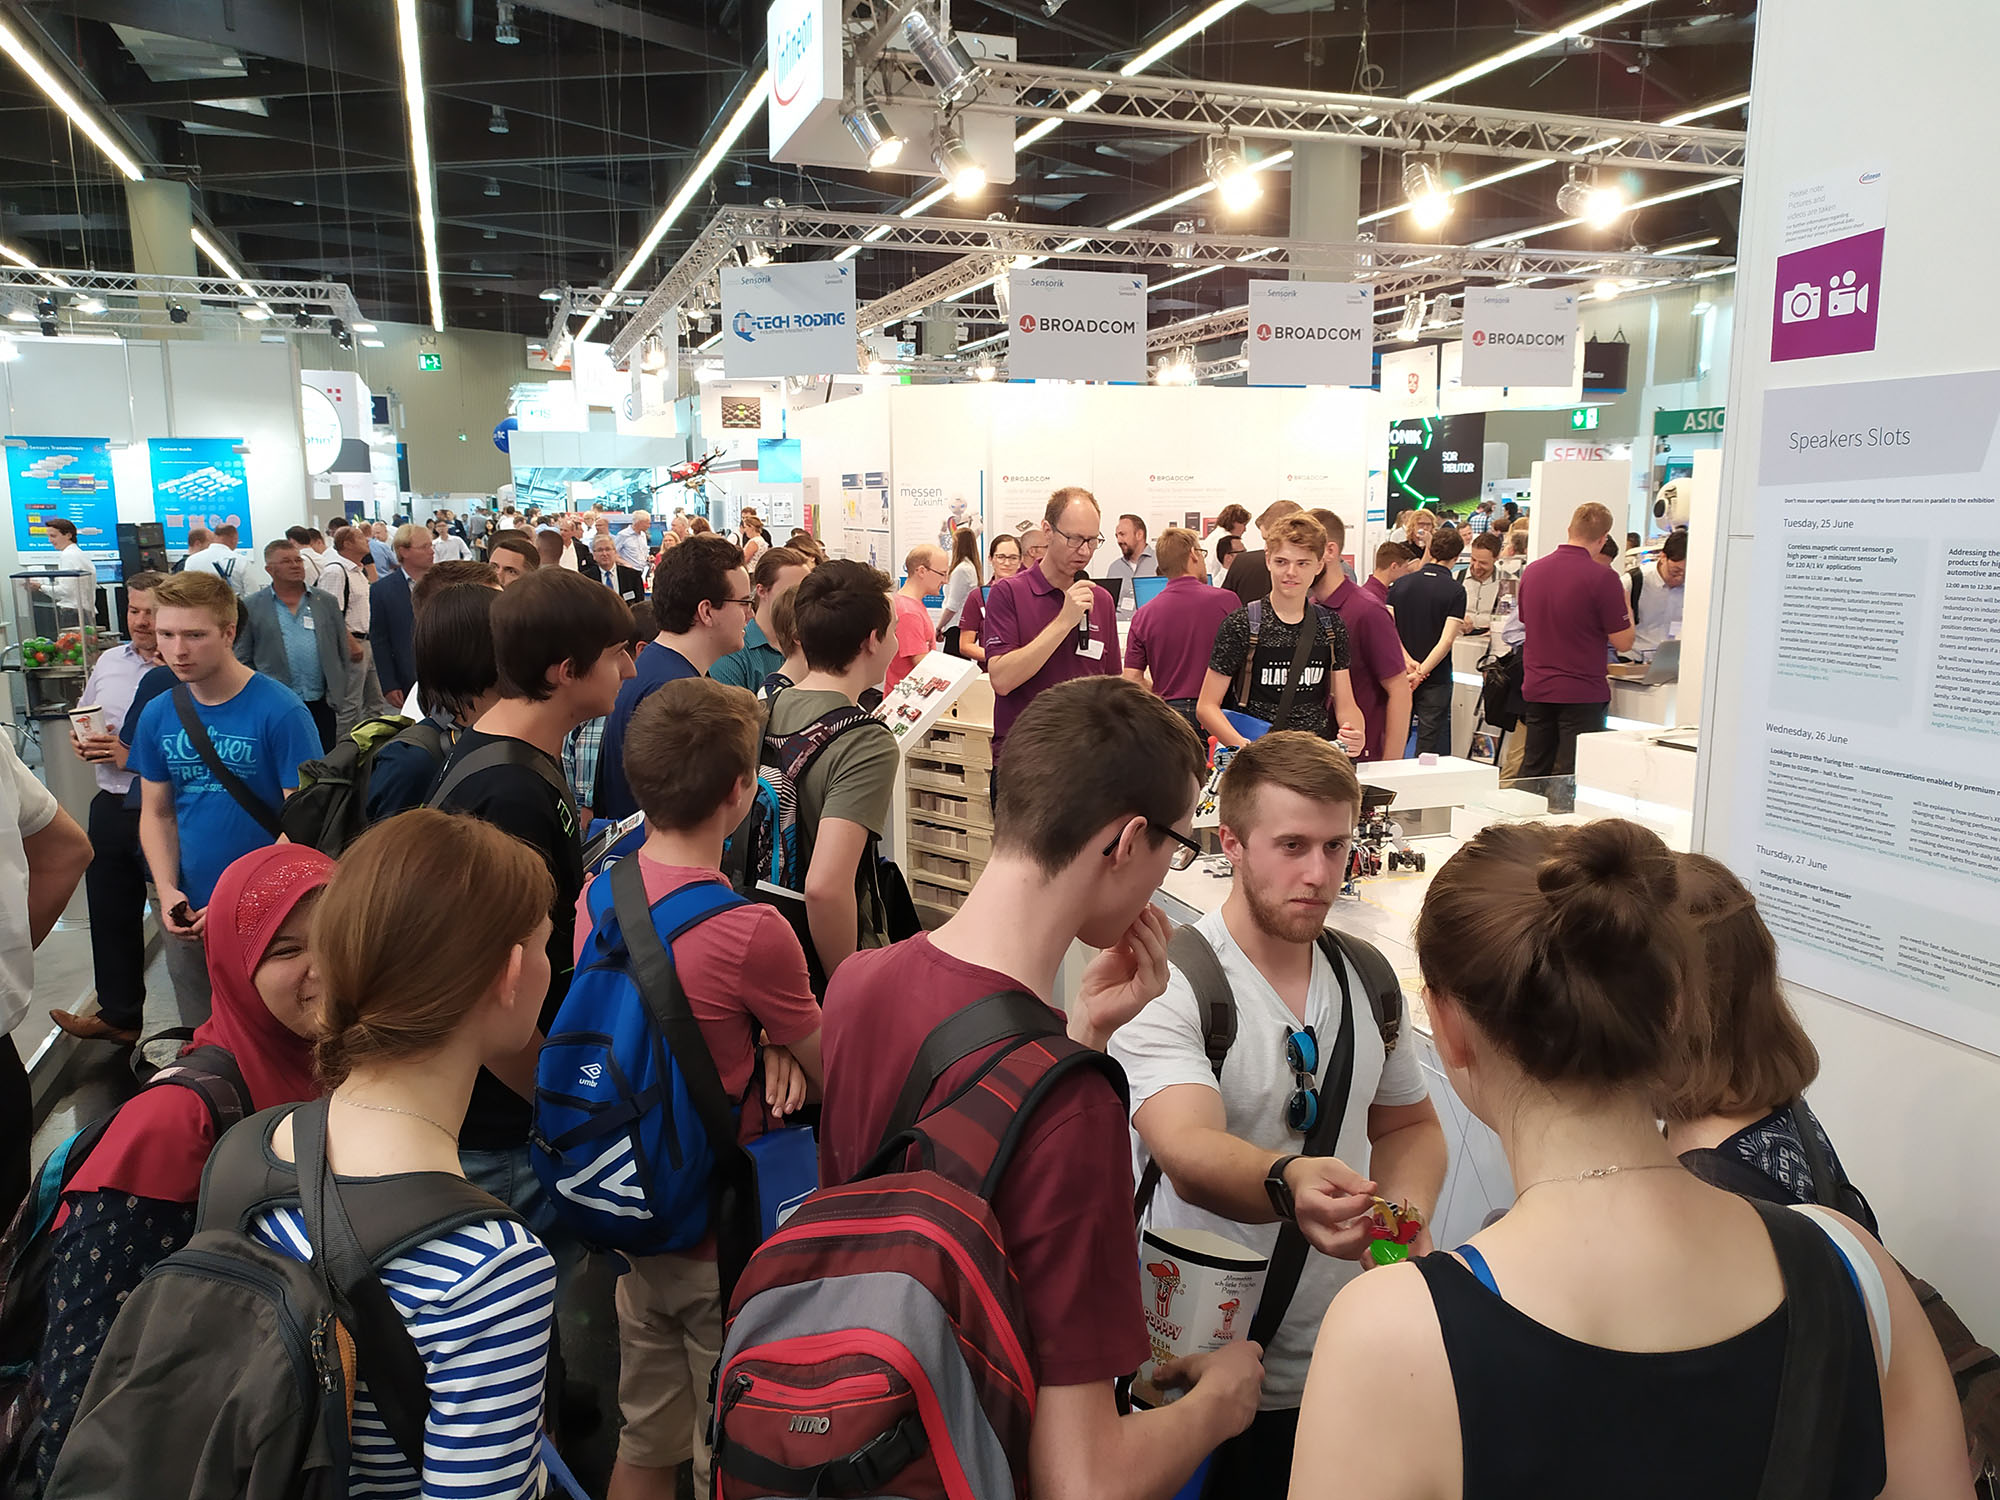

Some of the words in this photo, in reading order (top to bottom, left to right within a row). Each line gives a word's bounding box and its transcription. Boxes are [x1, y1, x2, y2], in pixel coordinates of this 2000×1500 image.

[741, 275, 771, 286] Sensorik
[1031, 278, 1064, 288] Sensorik
[1267, 289, 1297, 298] Sensorik
[1040, 318, 1136, 334] BROADCOM
[1275, 326, 1361, 341] BROADCOM
[1488, 333, 1565, 346] BROADCOM
[1789, 429, 1863, 453] Speakers
[1867, 427, 1911, 447] Slots
[900, 488, 942, 498] messen
[1784, 518, 1820, 530] Tuesday,
[1820, 519, 1831, 528] 25
[1833, 519, 1855, 528] June
[1812, 544, 1838, 552] magnetic
[1948, 548, 1987, 558] Addressing
[1878, 556, 1898, 564] family
[1948, 559, 1979, 567] products
[1980, 559, 1990, 567] for
[1826, 563, 1861, 571] applications
[1946, 569, 1987, 577] automotive
[1766, 722, 1814, 740] Wednesday,
[1815, 731, 1826, 741] 26
[1827, 734, 1849, 745] June
[1770, 748, 1792, 758] Looking
[1800, 753, 1812, 761] pass
[1824, 757, 1842, 767] Turing
[1859, 764, 1881, 773] natural
[1882, 768, 1925, 782] conversations
[1926, 777, 1953, 787] enabled
[1954, 781, 1962, 790] by
[1964, 784, 1996, 796] premium
[1756, 844, 1795, 865] Thursday,
[1795, 855, 1806, 865] 27
[1807, 857, 1828, 872] June
[1760, 869, 1792, 884] Prototyping
[1793, 878, 1802, 886] has
[1803, 881, 1819, 890] never
[1820, 885, 1834, 895] been
[1834, 889, 1852, 899] easier
[788, 1415, 830, 1434] NITRO
